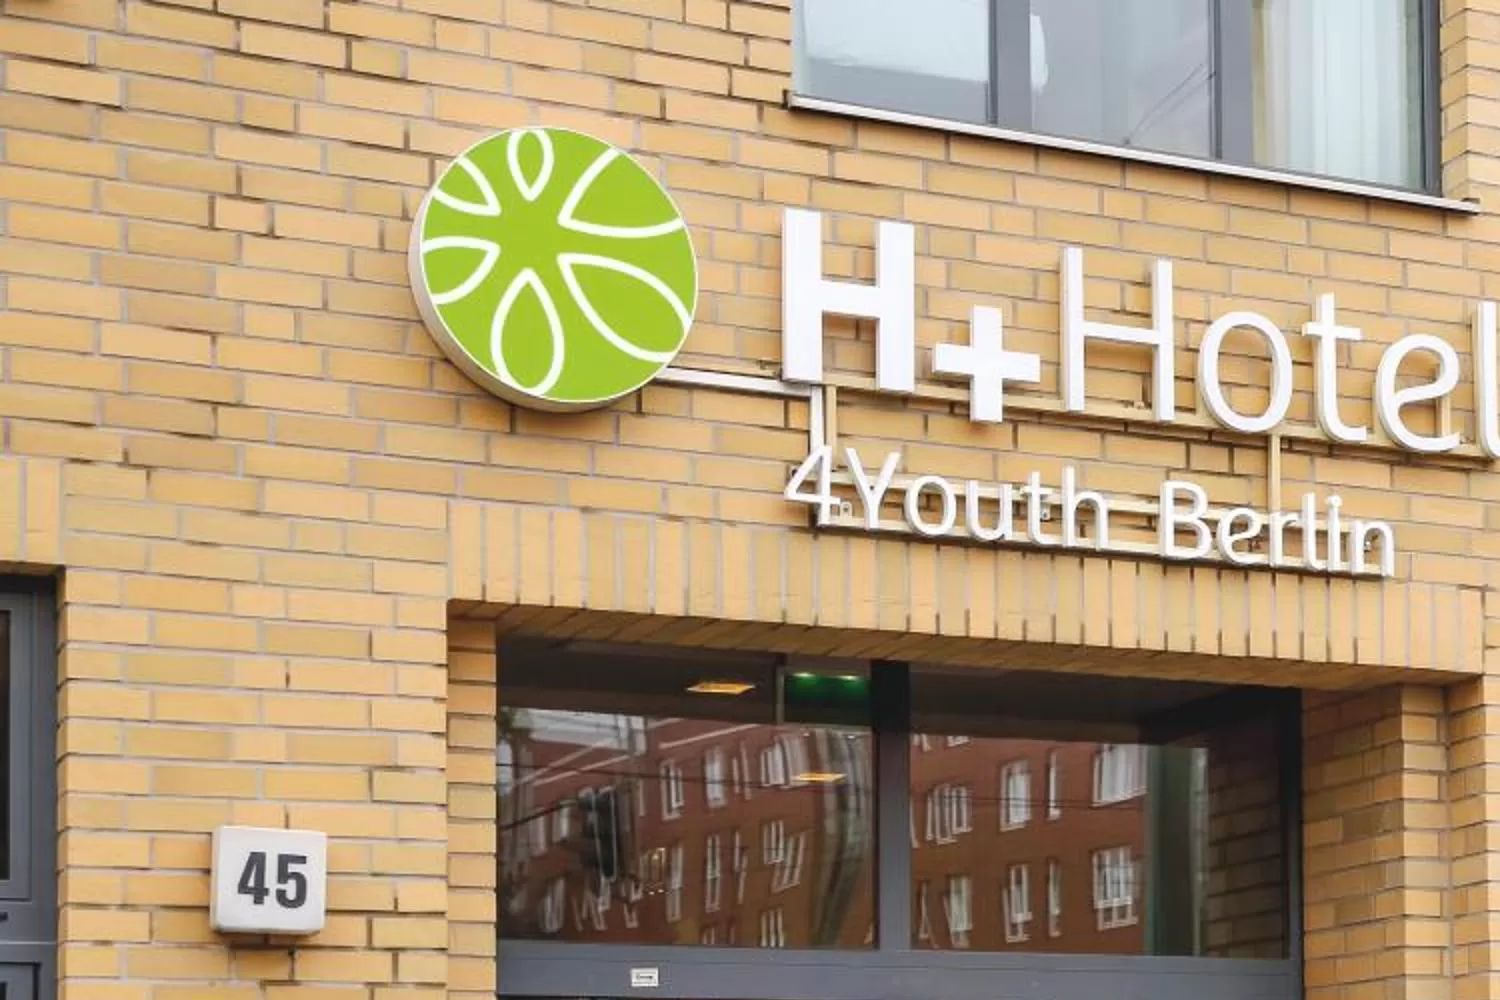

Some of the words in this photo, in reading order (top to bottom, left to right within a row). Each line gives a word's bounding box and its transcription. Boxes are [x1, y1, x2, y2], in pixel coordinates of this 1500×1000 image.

[784, 443, 1108, 551] 4Youth
[1158, 480, 1396, 577] Berlin
[237, 850, 307, 909] 45
